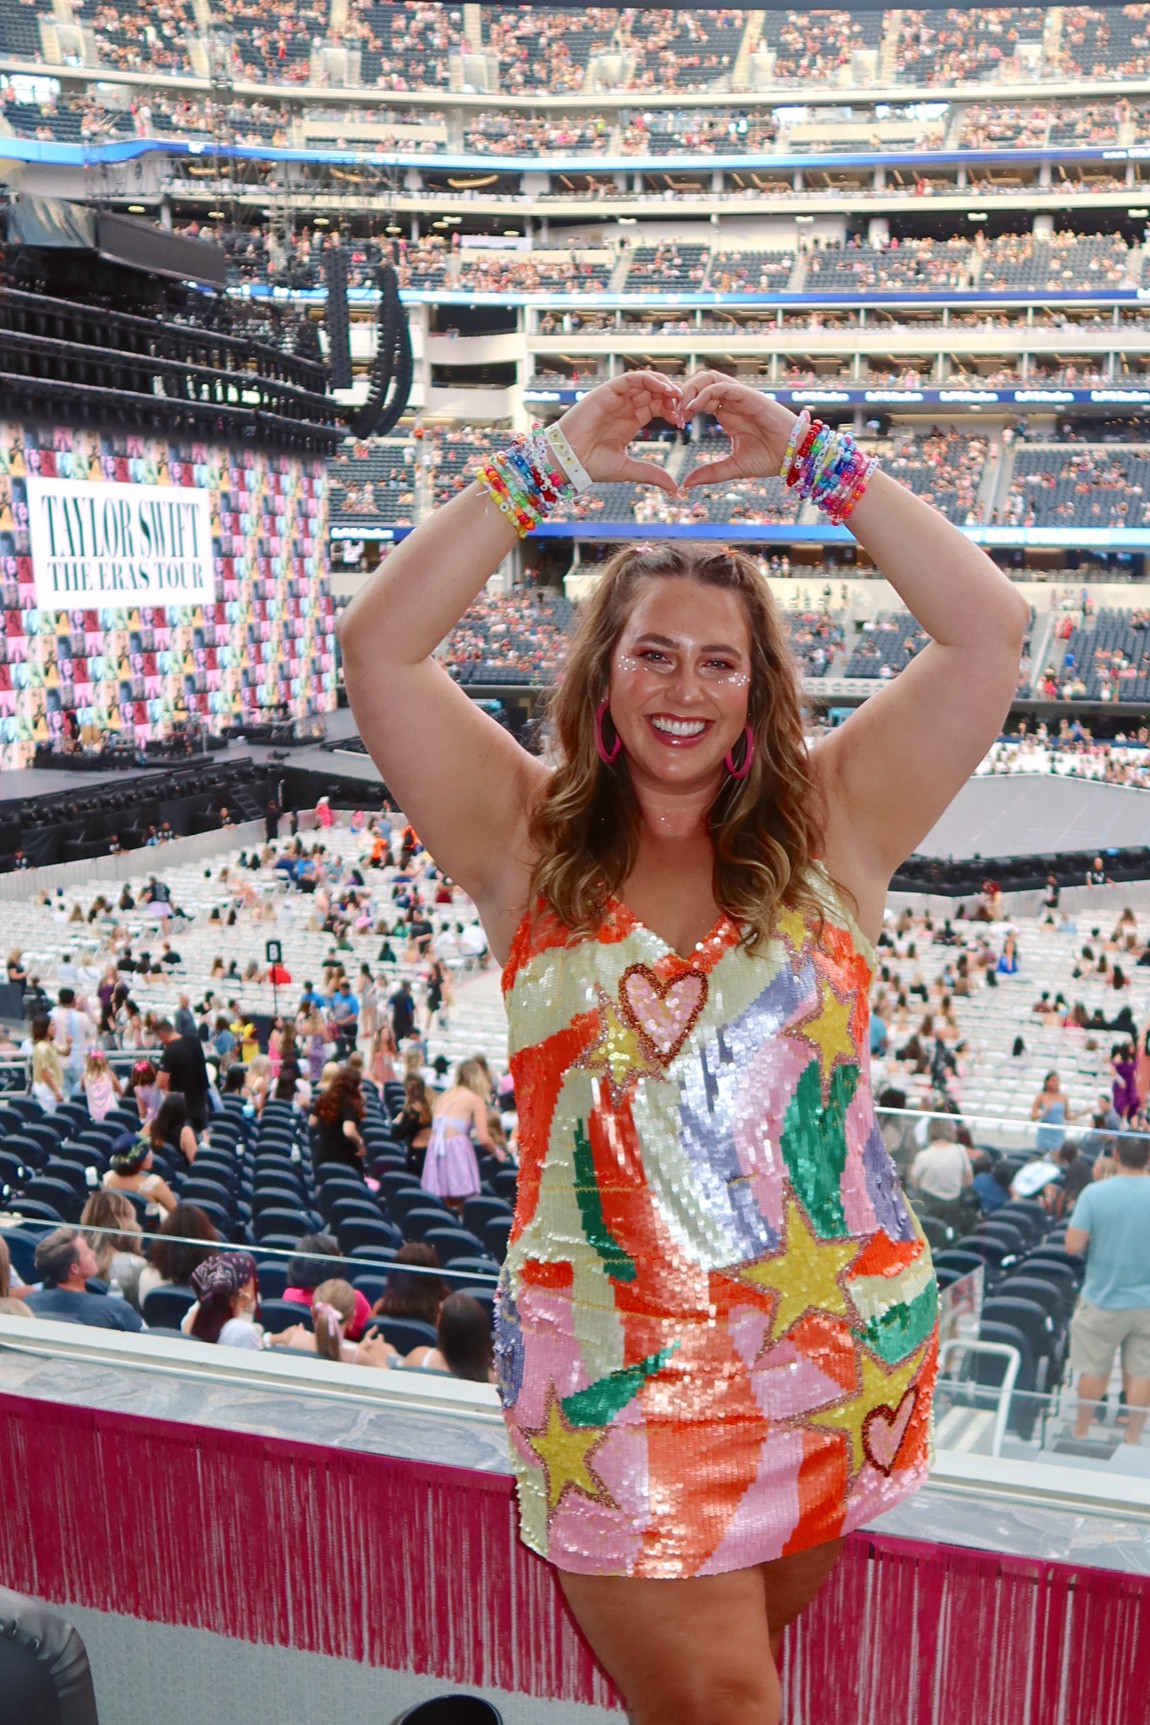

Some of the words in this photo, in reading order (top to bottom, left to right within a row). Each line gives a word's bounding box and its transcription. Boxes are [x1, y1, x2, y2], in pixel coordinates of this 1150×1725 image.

[41, 495, 134, 557] TAYLOR
[138, 499, 200, 559] SWIFT
[47, 562, 94, 592] THE
[98, 562, 151, 590] ERAS
[153, 562, 204, 589] TOUR
